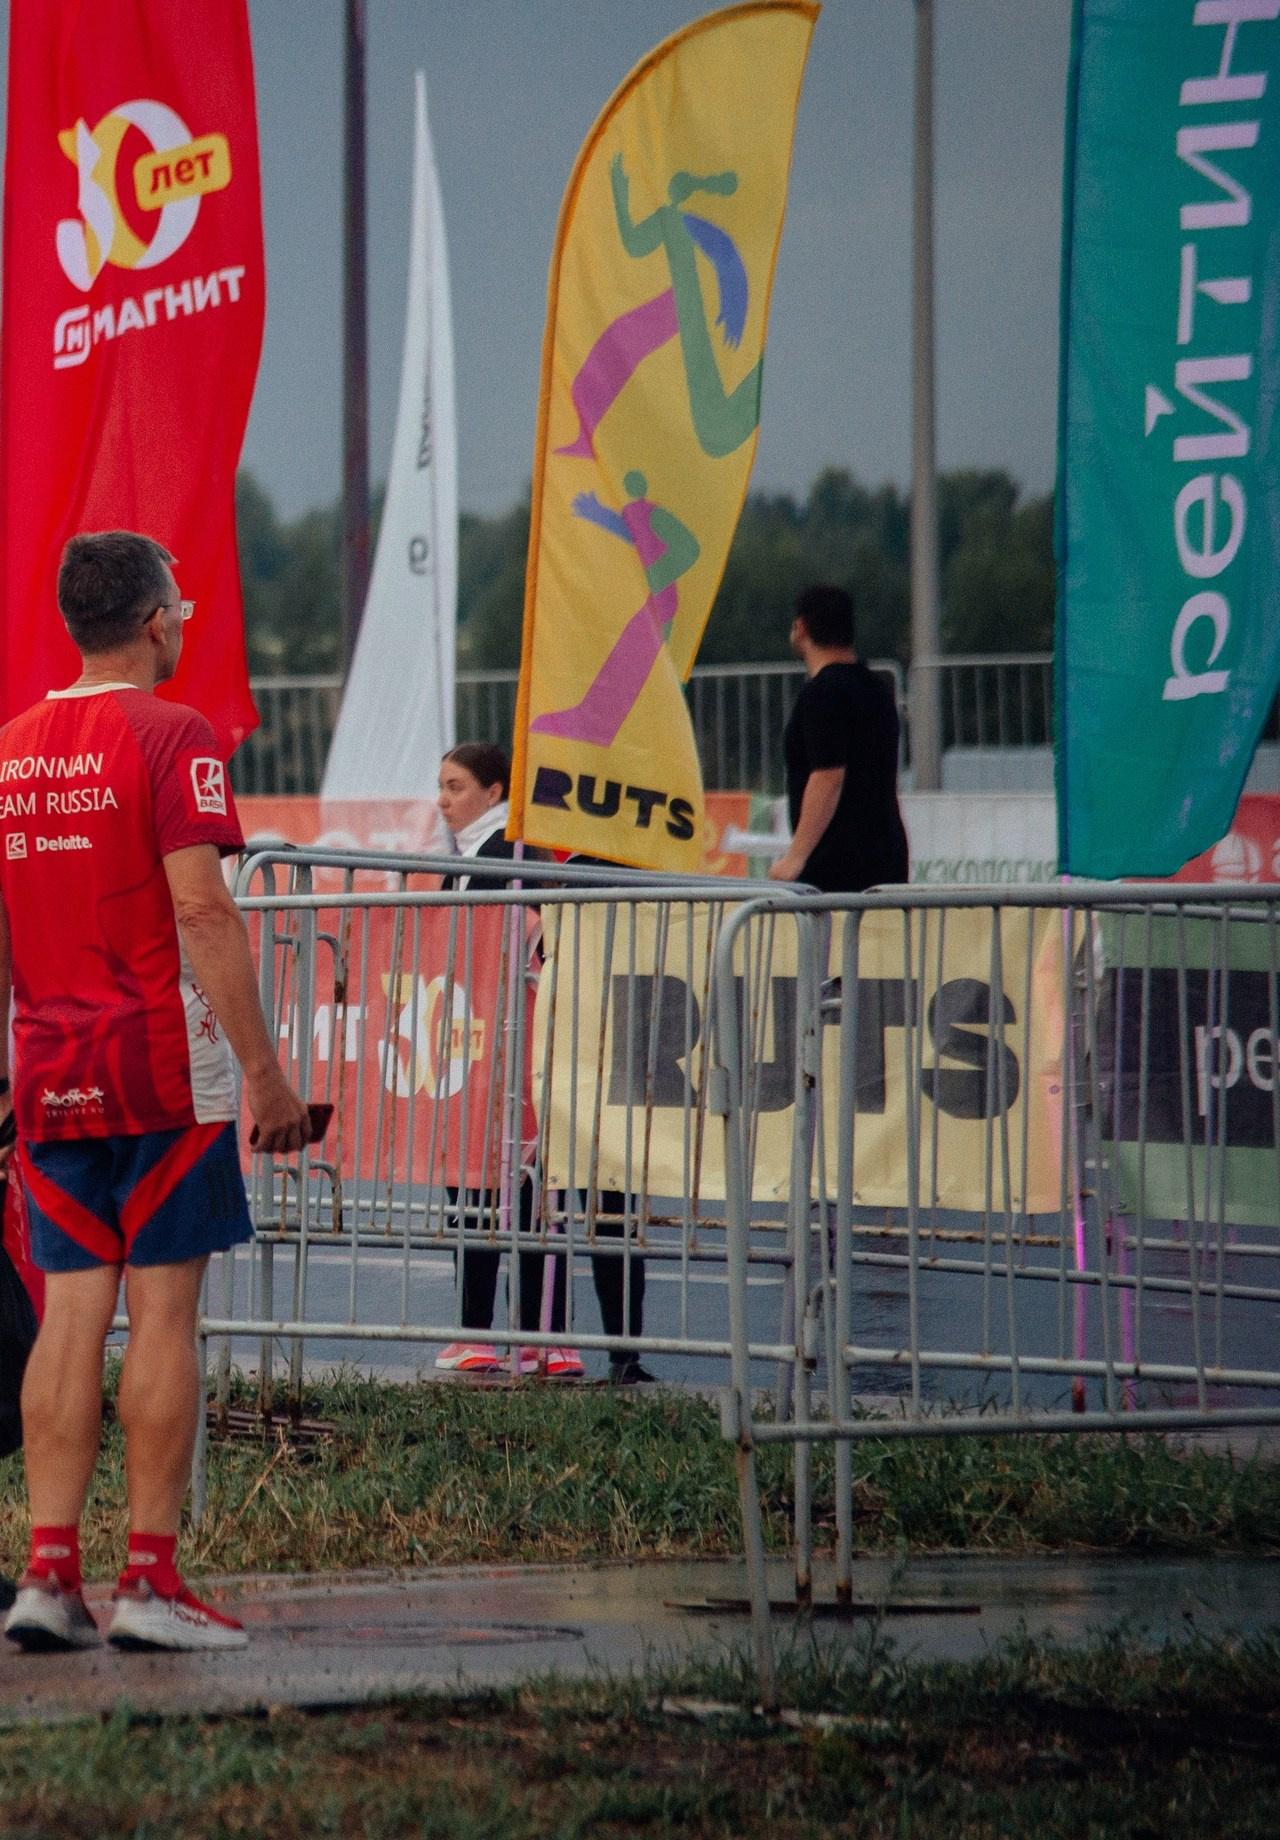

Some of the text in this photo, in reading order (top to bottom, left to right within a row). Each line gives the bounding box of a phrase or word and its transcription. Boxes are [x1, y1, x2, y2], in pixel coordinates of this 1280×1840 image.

[150, 151, 214, 194] лет
[94, 265, 245, 345] МАГНИТ
[46, 787, 119, 815] RUSSIA
[531, 767, 695, 841] RUTS
